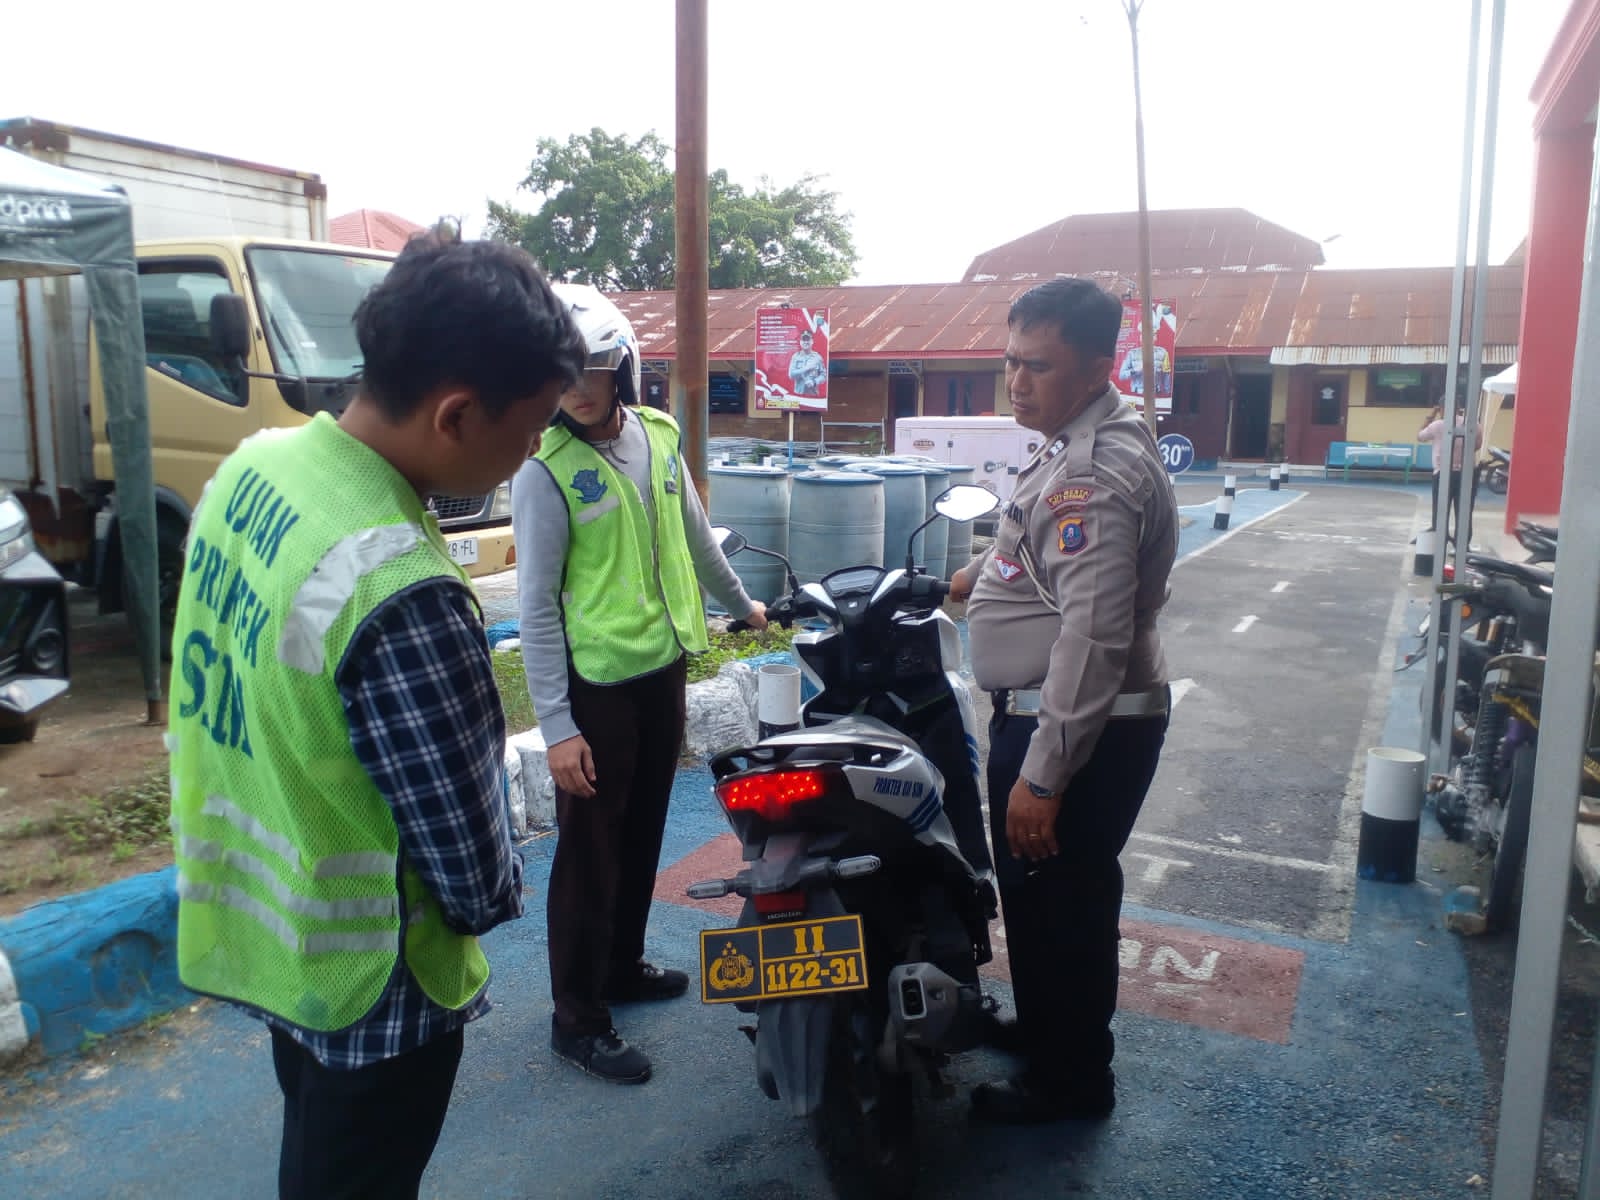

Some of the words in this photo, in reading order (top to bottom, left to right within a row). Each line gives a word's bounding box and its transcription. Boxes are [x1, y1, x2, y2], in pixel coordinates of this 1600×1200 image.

[1160, 444, 1181, 466] 30
[225, 467, 300, 569] UJIAN
[767, 956, 859, 992] 1122-31
